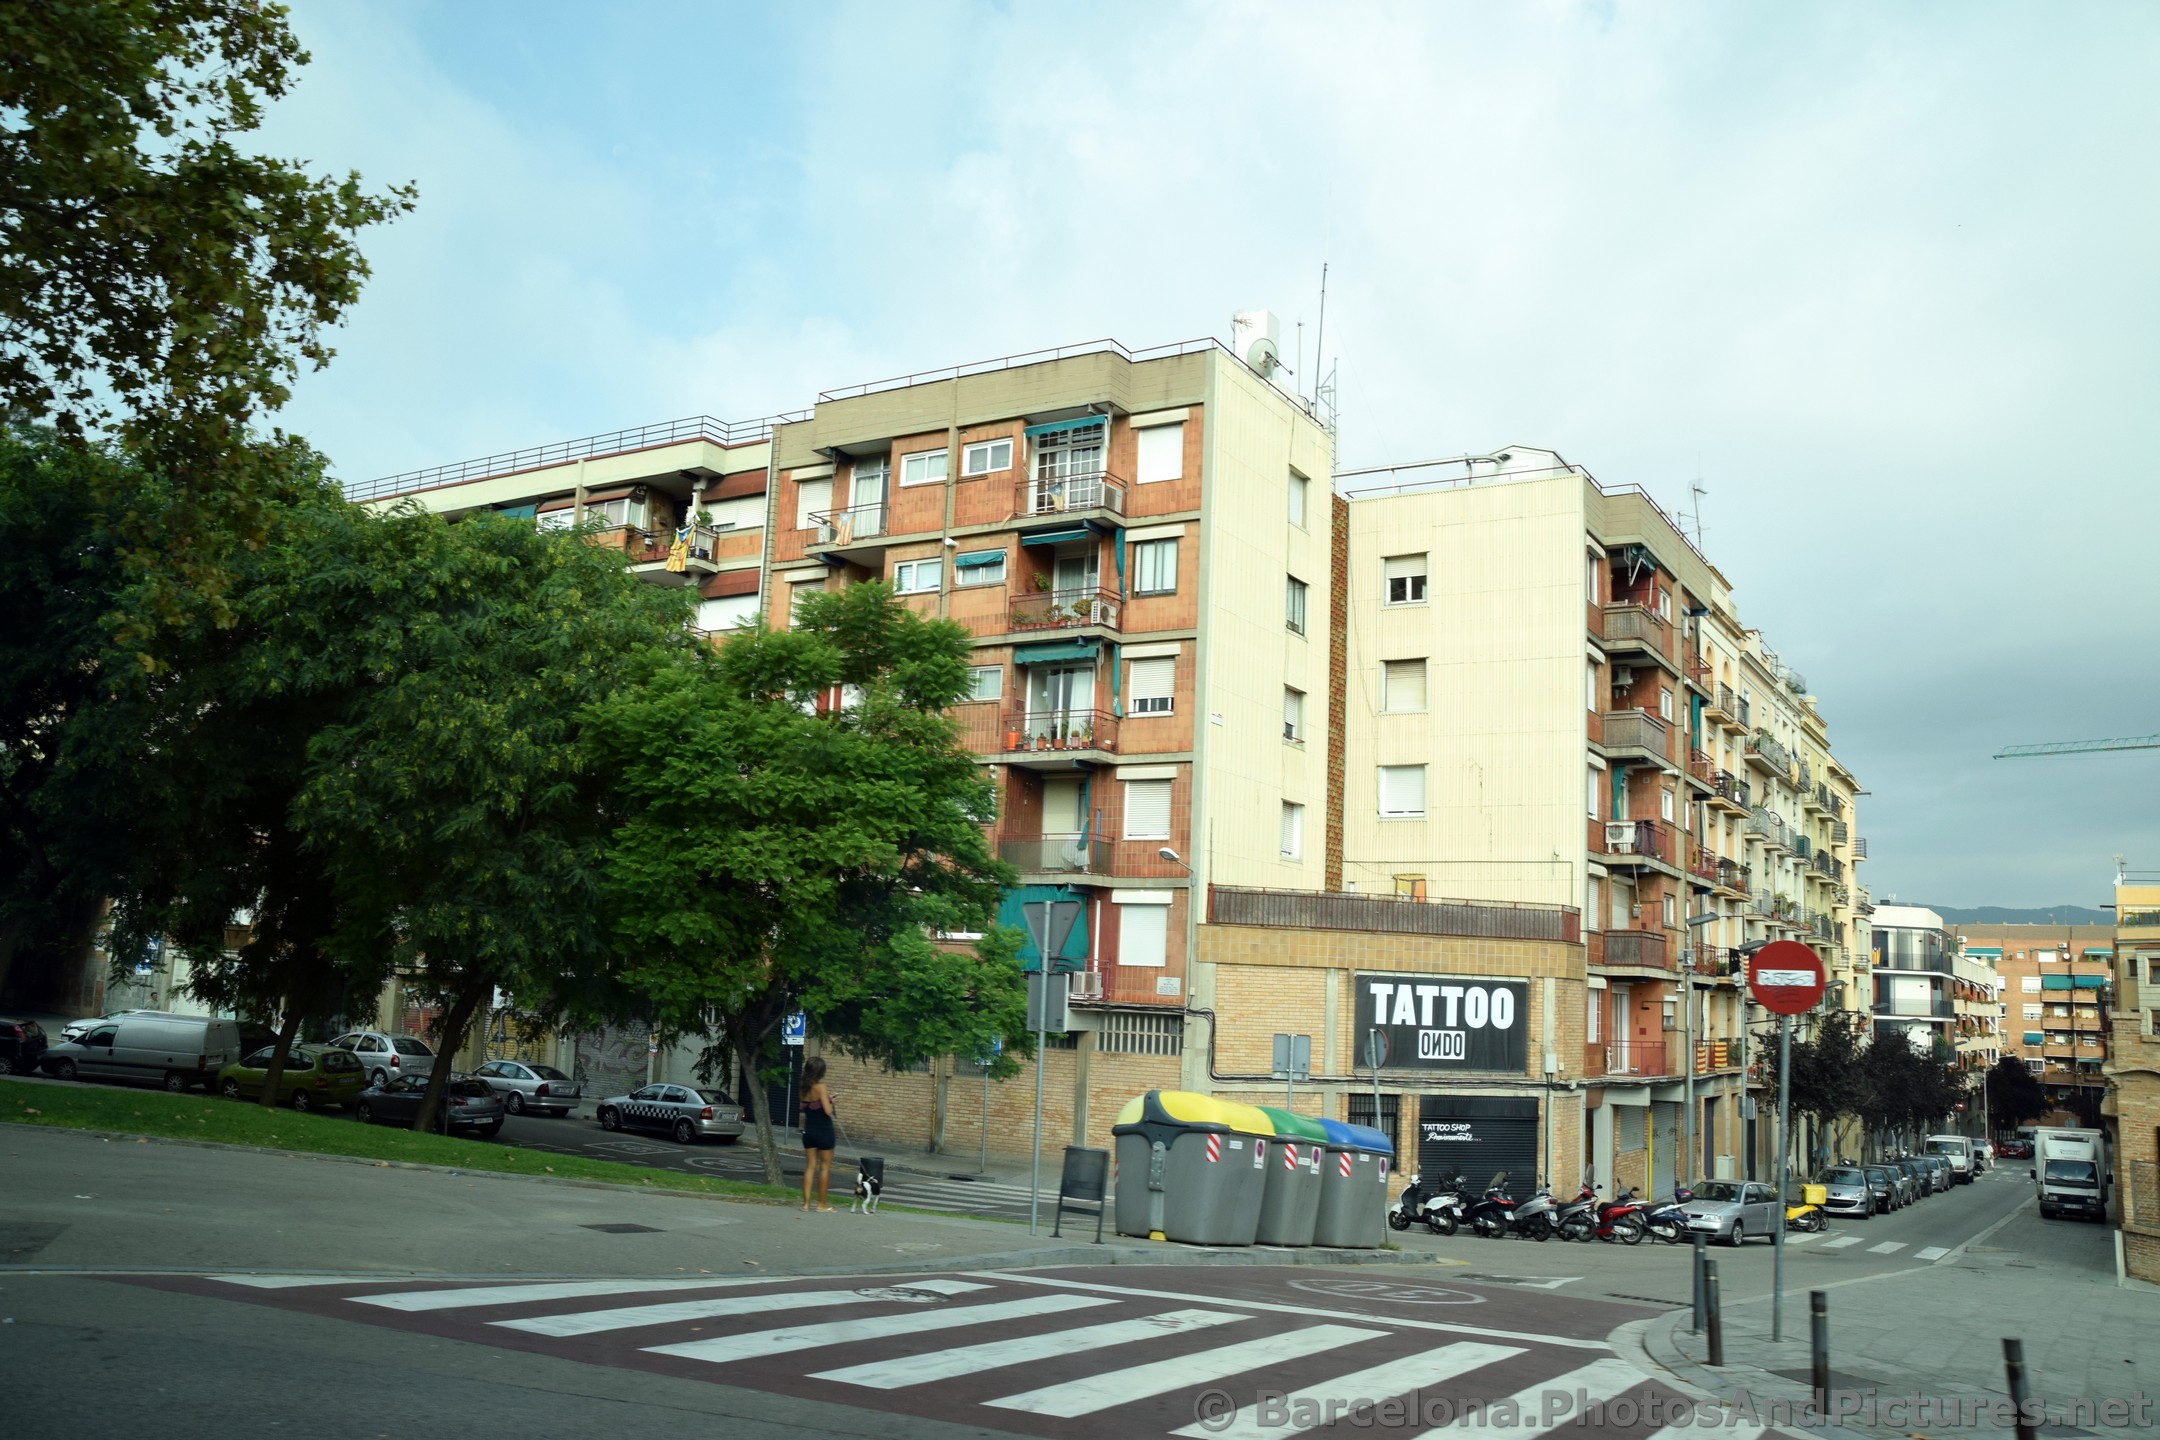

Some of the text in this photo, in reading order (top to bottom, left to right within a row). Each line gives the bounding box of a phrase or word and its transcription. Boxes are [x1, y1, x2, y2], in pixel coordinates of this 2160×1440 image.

[1370, 983, 1514, 1030] TATTOO
[1421, 1123, 1471, 1131] TATTOO SHOP
